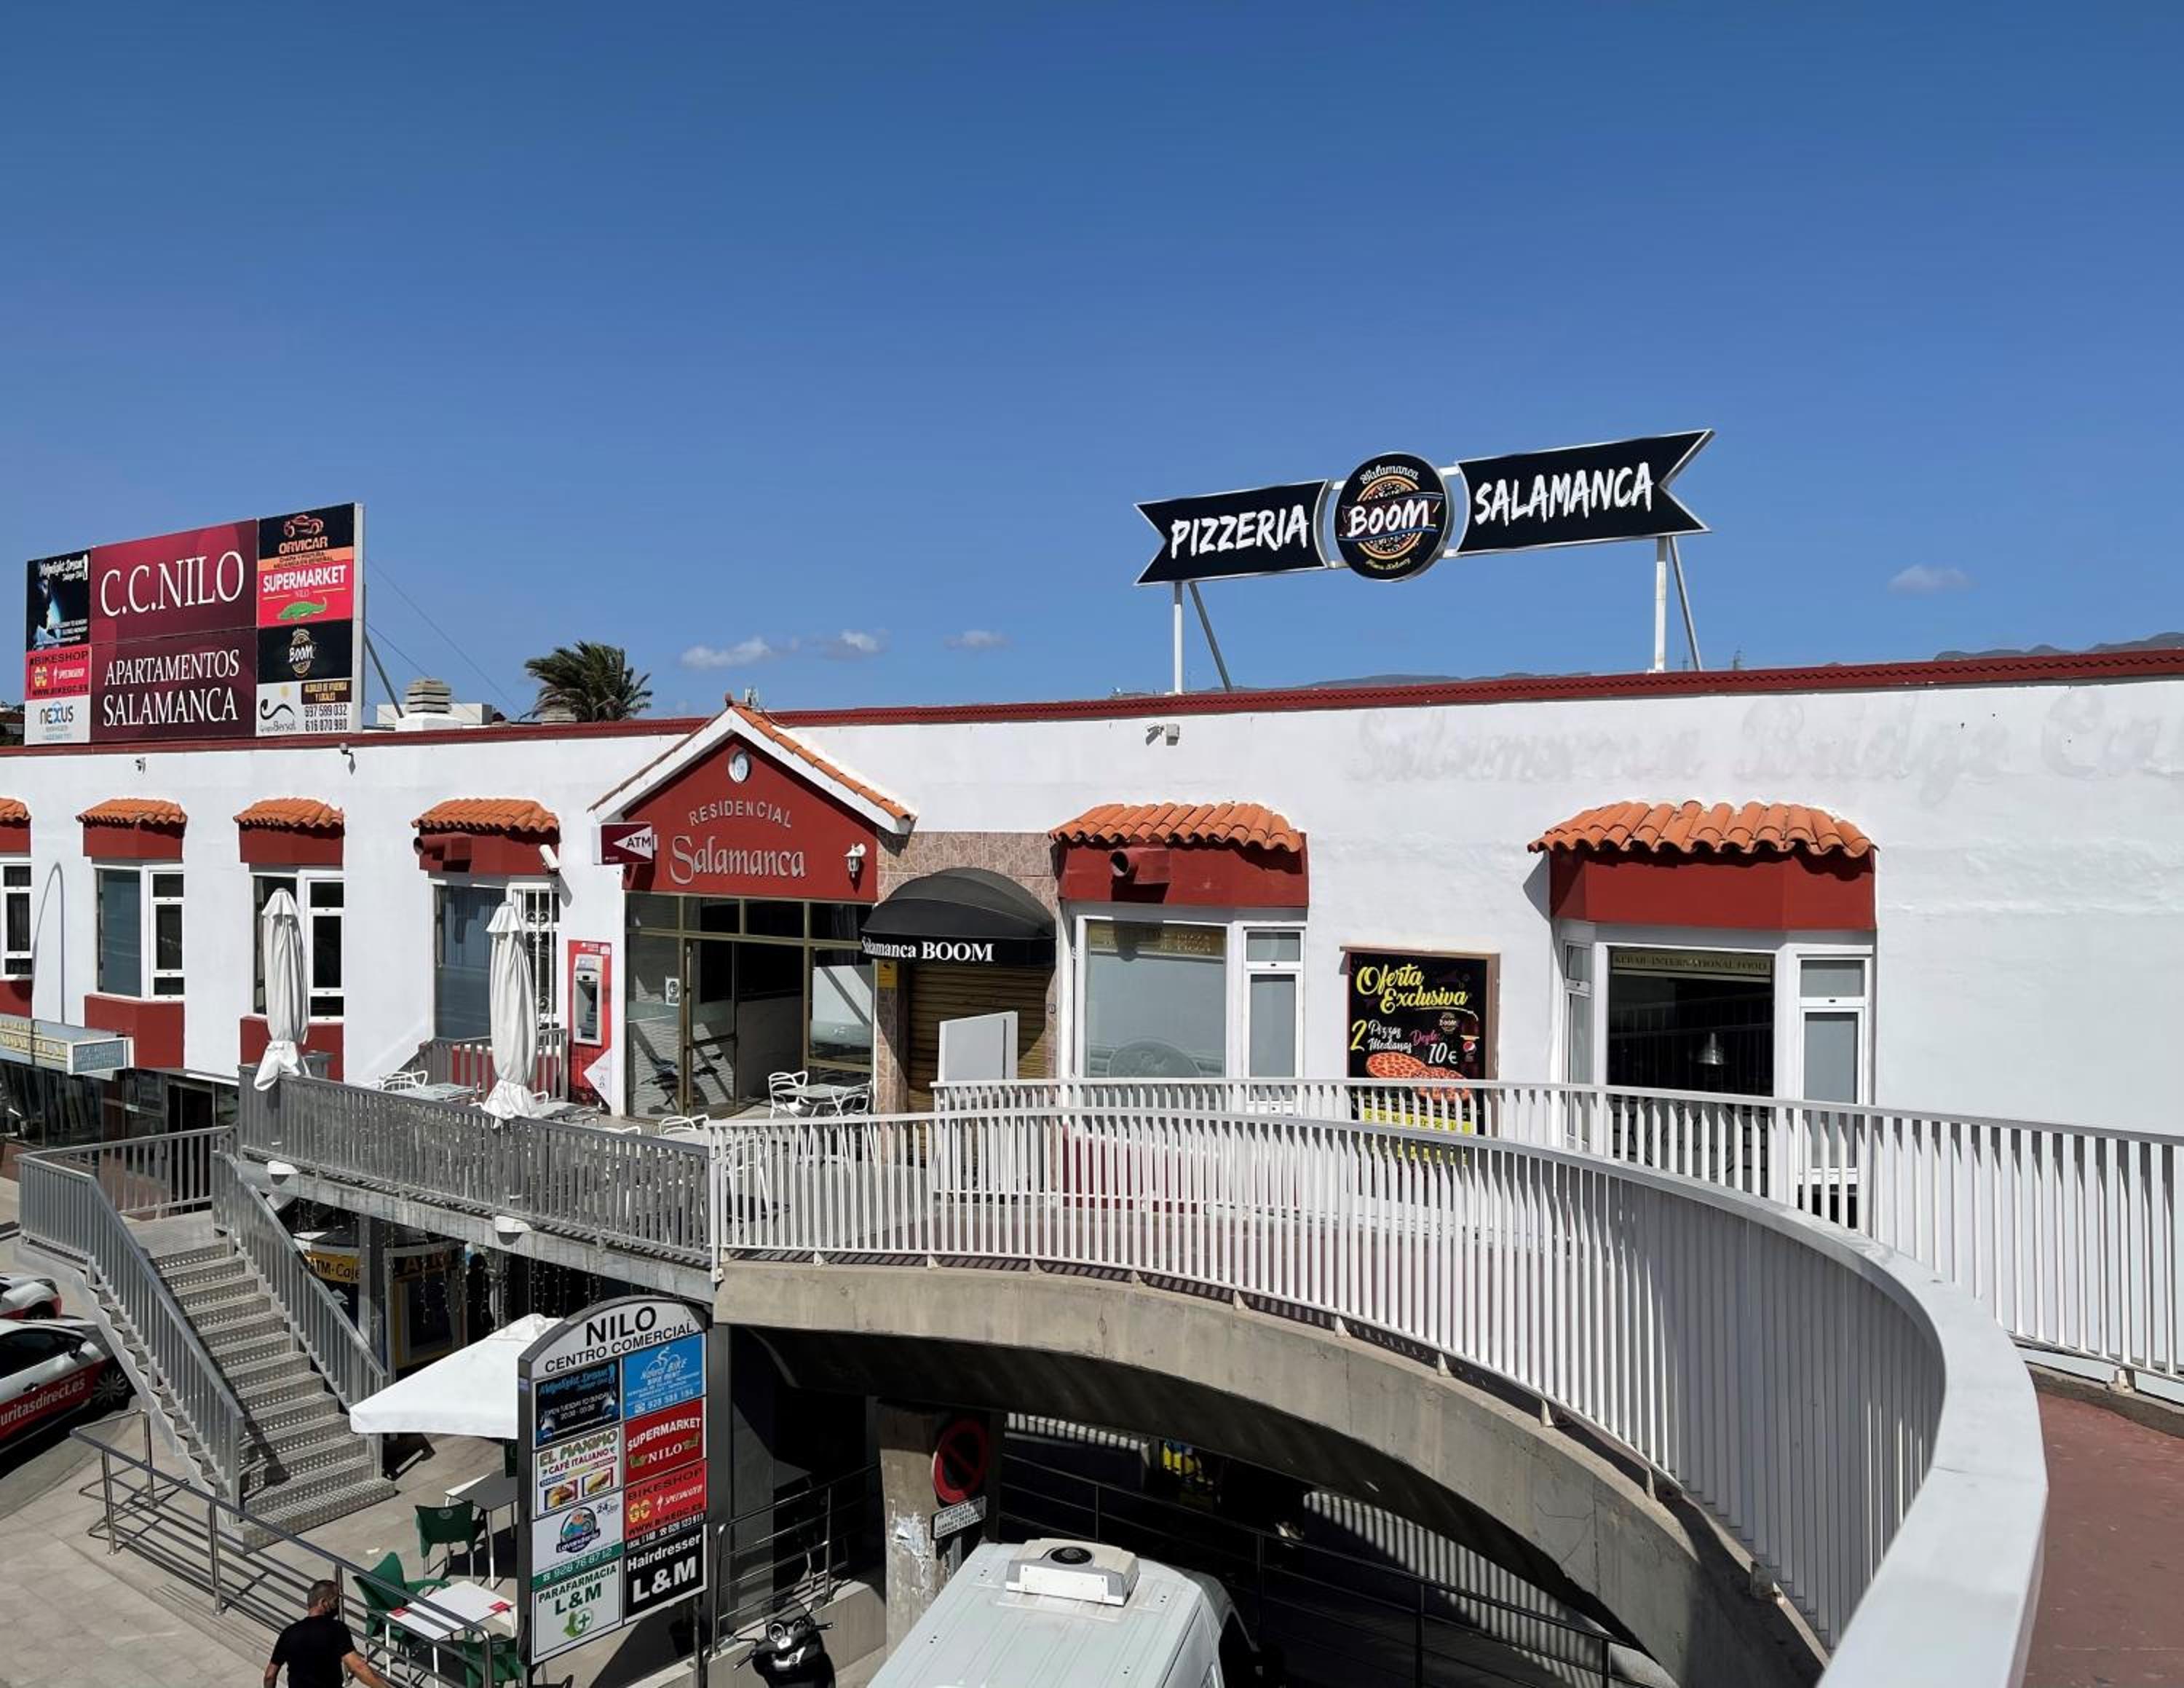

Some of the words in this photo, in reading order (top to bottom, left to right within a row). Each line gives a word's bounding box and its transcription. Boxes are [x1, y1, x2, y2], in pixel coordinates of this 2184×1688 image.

[1359, 465, 1420, 485] Salamanca
[1171, 504, 1309, 559] PIZZERIA
[1474, 462, 1654, 526] SALAMANCA
[1347, 499, 1431, 537] BOOM
[279, 536, 328, 554] ORVICAR
[263, 564, 347, 593] SUPERMARKET
[105, 649, 239, 686] APARTAMENTOS
[289, 644, 314, 663] BOOM
[103, 687, 238, 727] SALAMANCA
[689, 800, 792, 828] RESIDENCIAL
[625, 836, 652, 848] ATM
[670, 835, 805, 885] Salamanca
[862, 936, 917, 958] Salamanca
[921, 941, 994, 962] BOOM
[1356, 963, 1425, 995] Oferta
[1380, 985, 1468, 1014] Exclusiva
[1350, 1019, 1368, 1052] 2
[1368, 1019, 1401, 1039] Pizzas
[586, 1306, 657, 1346] NILO
[545, 1346, 606, 1373] CENTRO
[612, 1322, 694, 1354] COMERCIAL
[627, 1417, 701, 1452] SUPERMARKET
[539, 1451, 557, 1467] EL
[571, 1448, 609, 1467] ITALIANO
[648, 1443, 683, 1464] NILO
[628, 1467, 703, 1500] BIKESHOP
[627, 1534, 701, 1571] Hairdresser
[538, 1565, 617, 1604] PARAFARMACIA
[554, 1563, 573, 1578] 928
[633, 1556, 696, 1603] L&M
[554, 1582, 602, 1615] L&M
